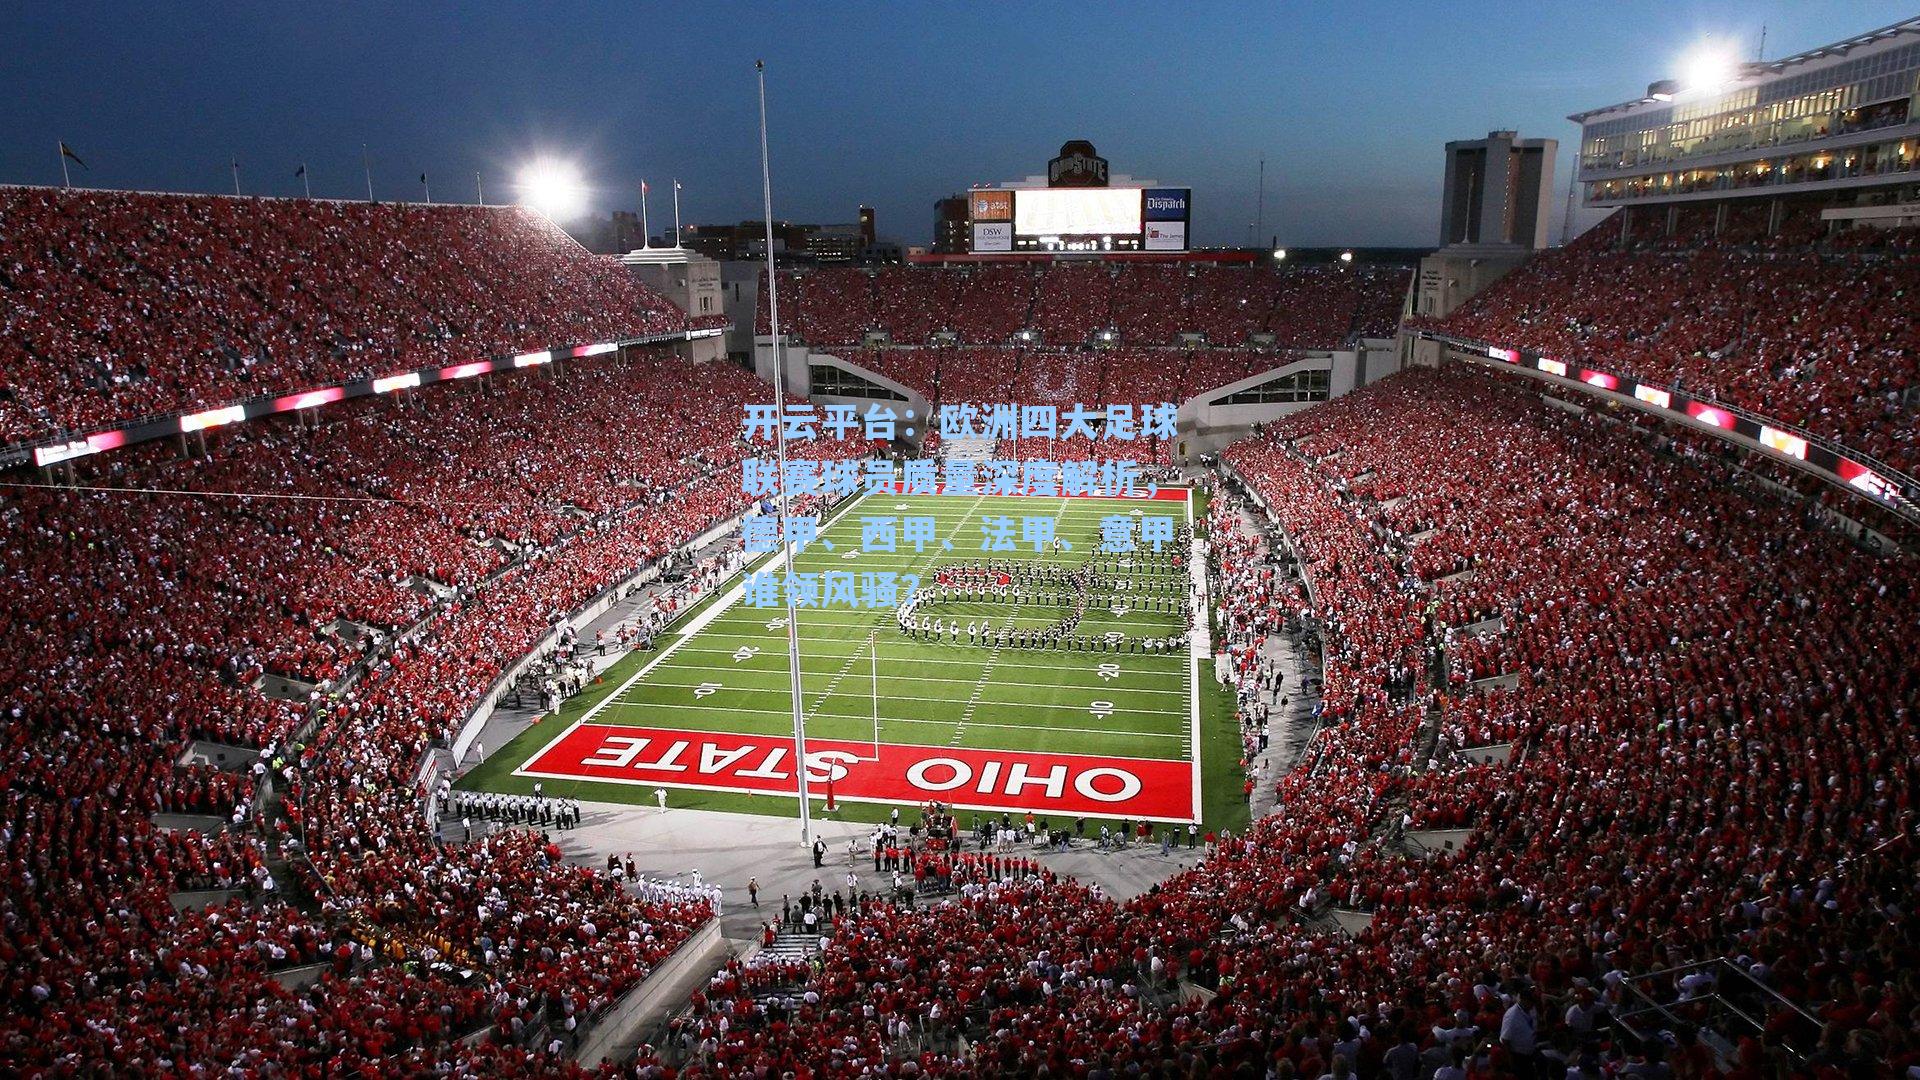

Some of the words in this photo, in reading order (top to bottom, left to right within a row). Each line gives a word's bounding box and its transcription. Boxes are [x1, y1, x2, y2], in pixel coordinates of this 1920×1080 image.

[1147, 198, 1185, 211] Dispatch
[983, 228, 1002, 236] DSW
[1097, 663, 1120, 677] 20
[693, 682, 723, 695] 10
[1089, 701, 1114, 714] 10
[580, 735, 860, 783] STATE
[906, 757, 1142, 803] OHIO
